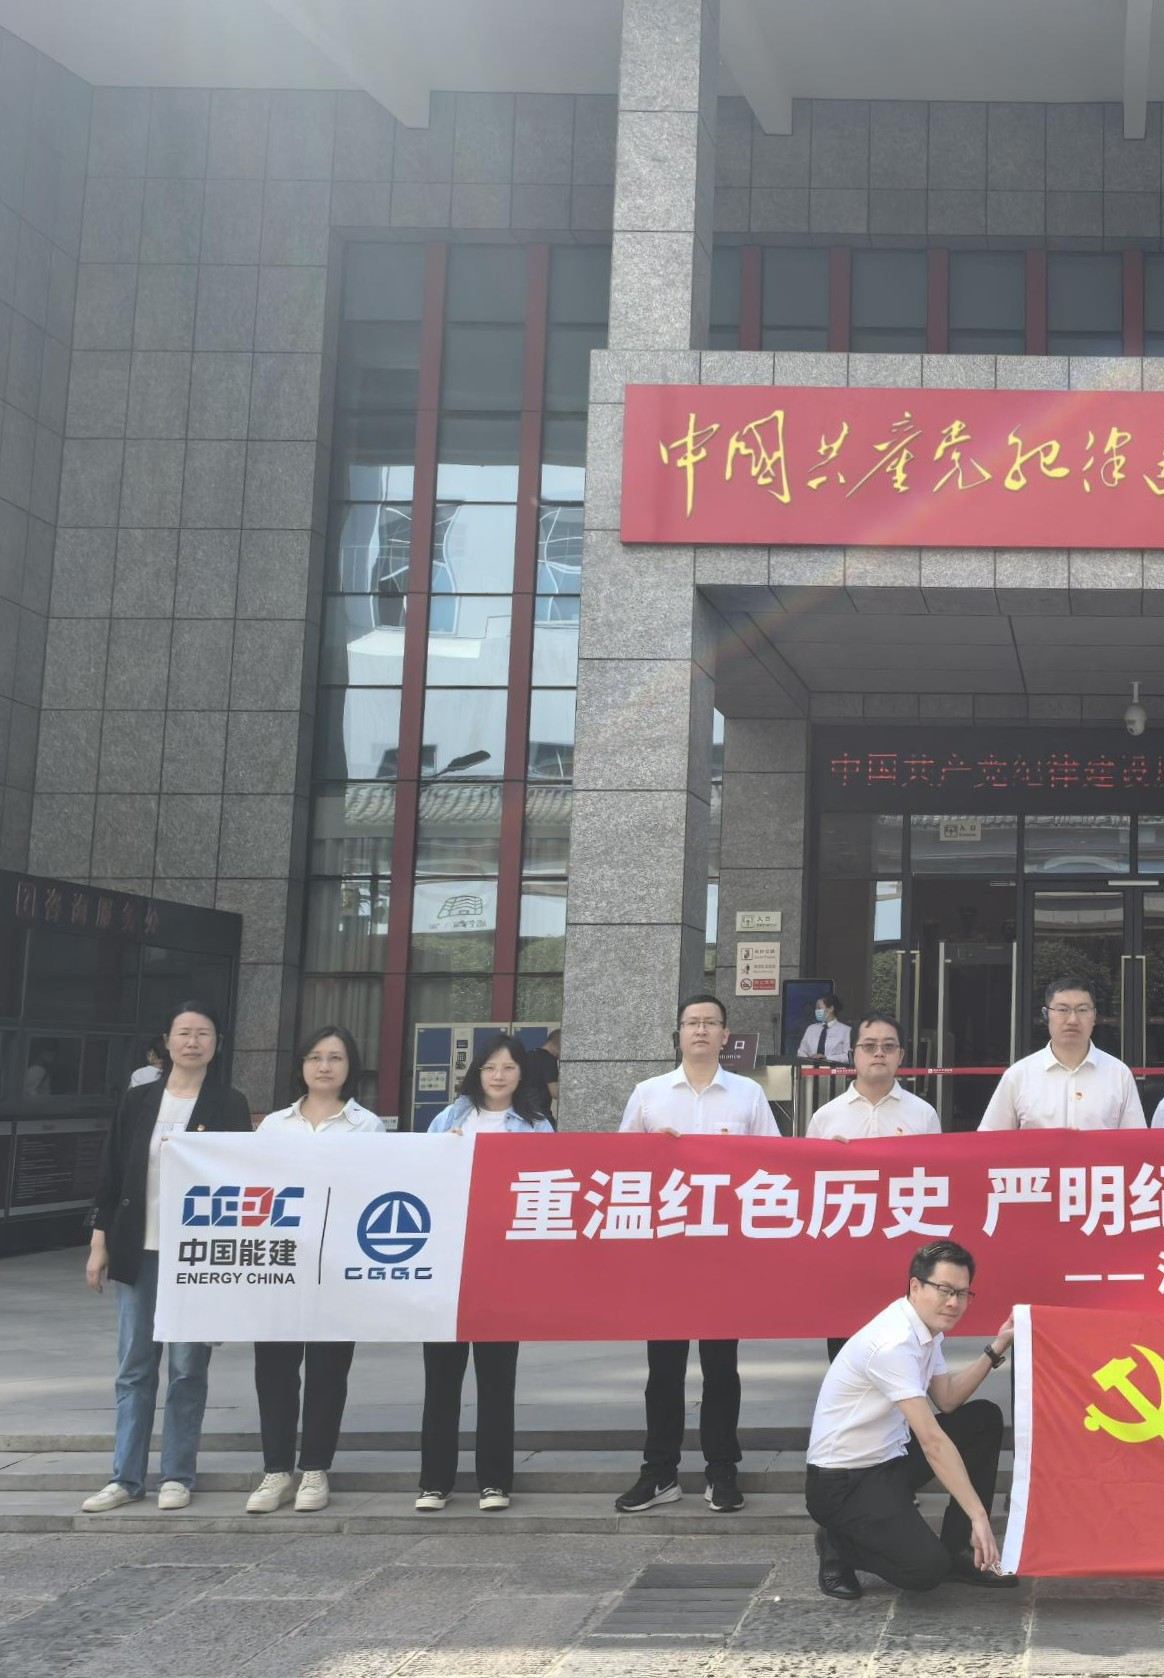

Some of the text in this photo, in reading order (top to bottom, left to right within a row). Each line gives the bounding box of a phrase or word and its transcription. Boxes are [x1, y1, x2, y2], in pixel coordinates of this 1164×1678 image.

[505, 1167, 953, 1240] 重温红色历史
[178, 1238, 297, 1267] 中国能建
[176, 1272, 295, 1284] ENERGY CHINA
